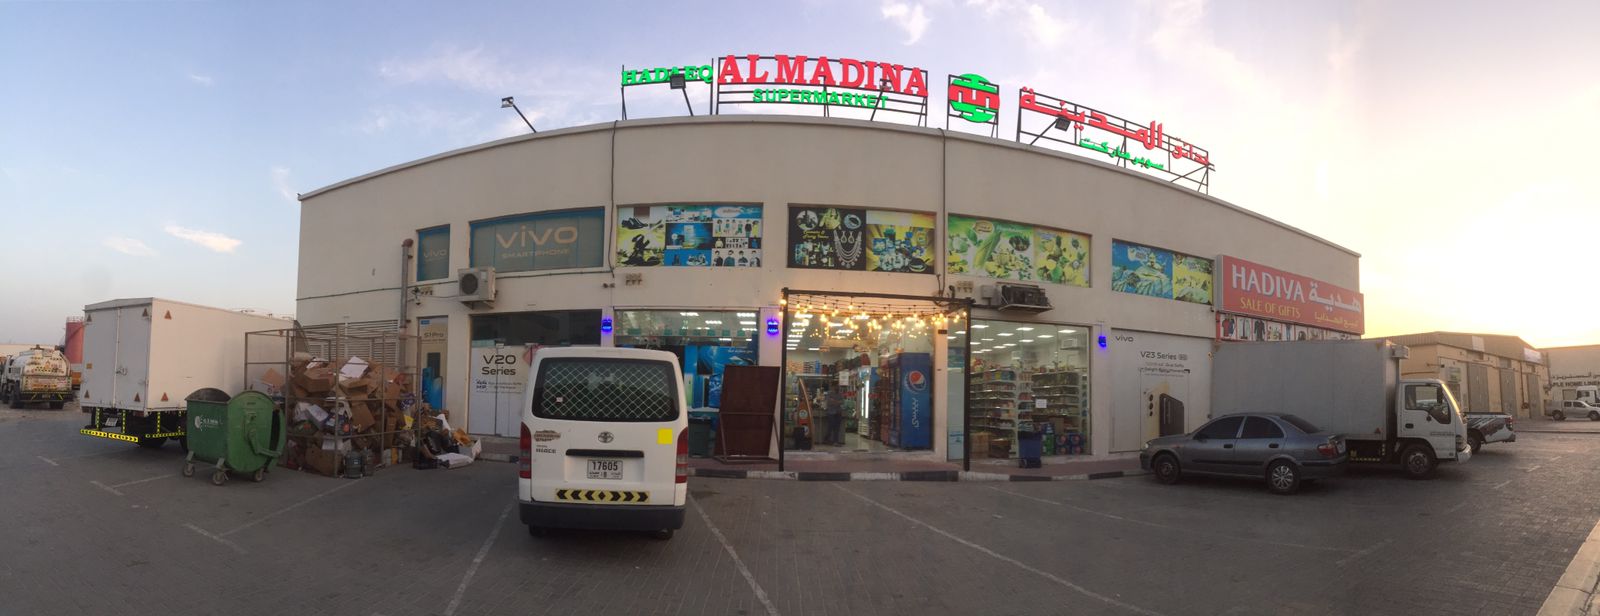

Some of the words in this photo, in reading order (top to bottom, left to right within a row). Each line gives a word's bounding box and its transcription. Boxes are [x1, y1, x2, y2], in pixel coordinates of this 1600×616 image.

[621, 64, 714, 84] HADAEQ
[718, 54, 770, 85] AL
[774, 55, 929, 98] MADINA
[752, 88, 889, 109] SUPERMARKET
[1020, 86, 1163, 150] المدينة
[496, 224, 578, 248] vivo
[1232, 264, 1306, 303] HADIYA
[1240, 297, 1262, 311] SALE
[1265, 302, 1276, 314] OF
[1278, 305, 1301, 319] GIFTS
[1308, 281, 1360, 313] هدية
[482, 354, 517, 365] V20
[1140, 351, 1156, 359] V23
[1157, 351, 1177, 360] Series
[481, 366, 517, 376] Series
[592, 461, 618, 471] 17605
